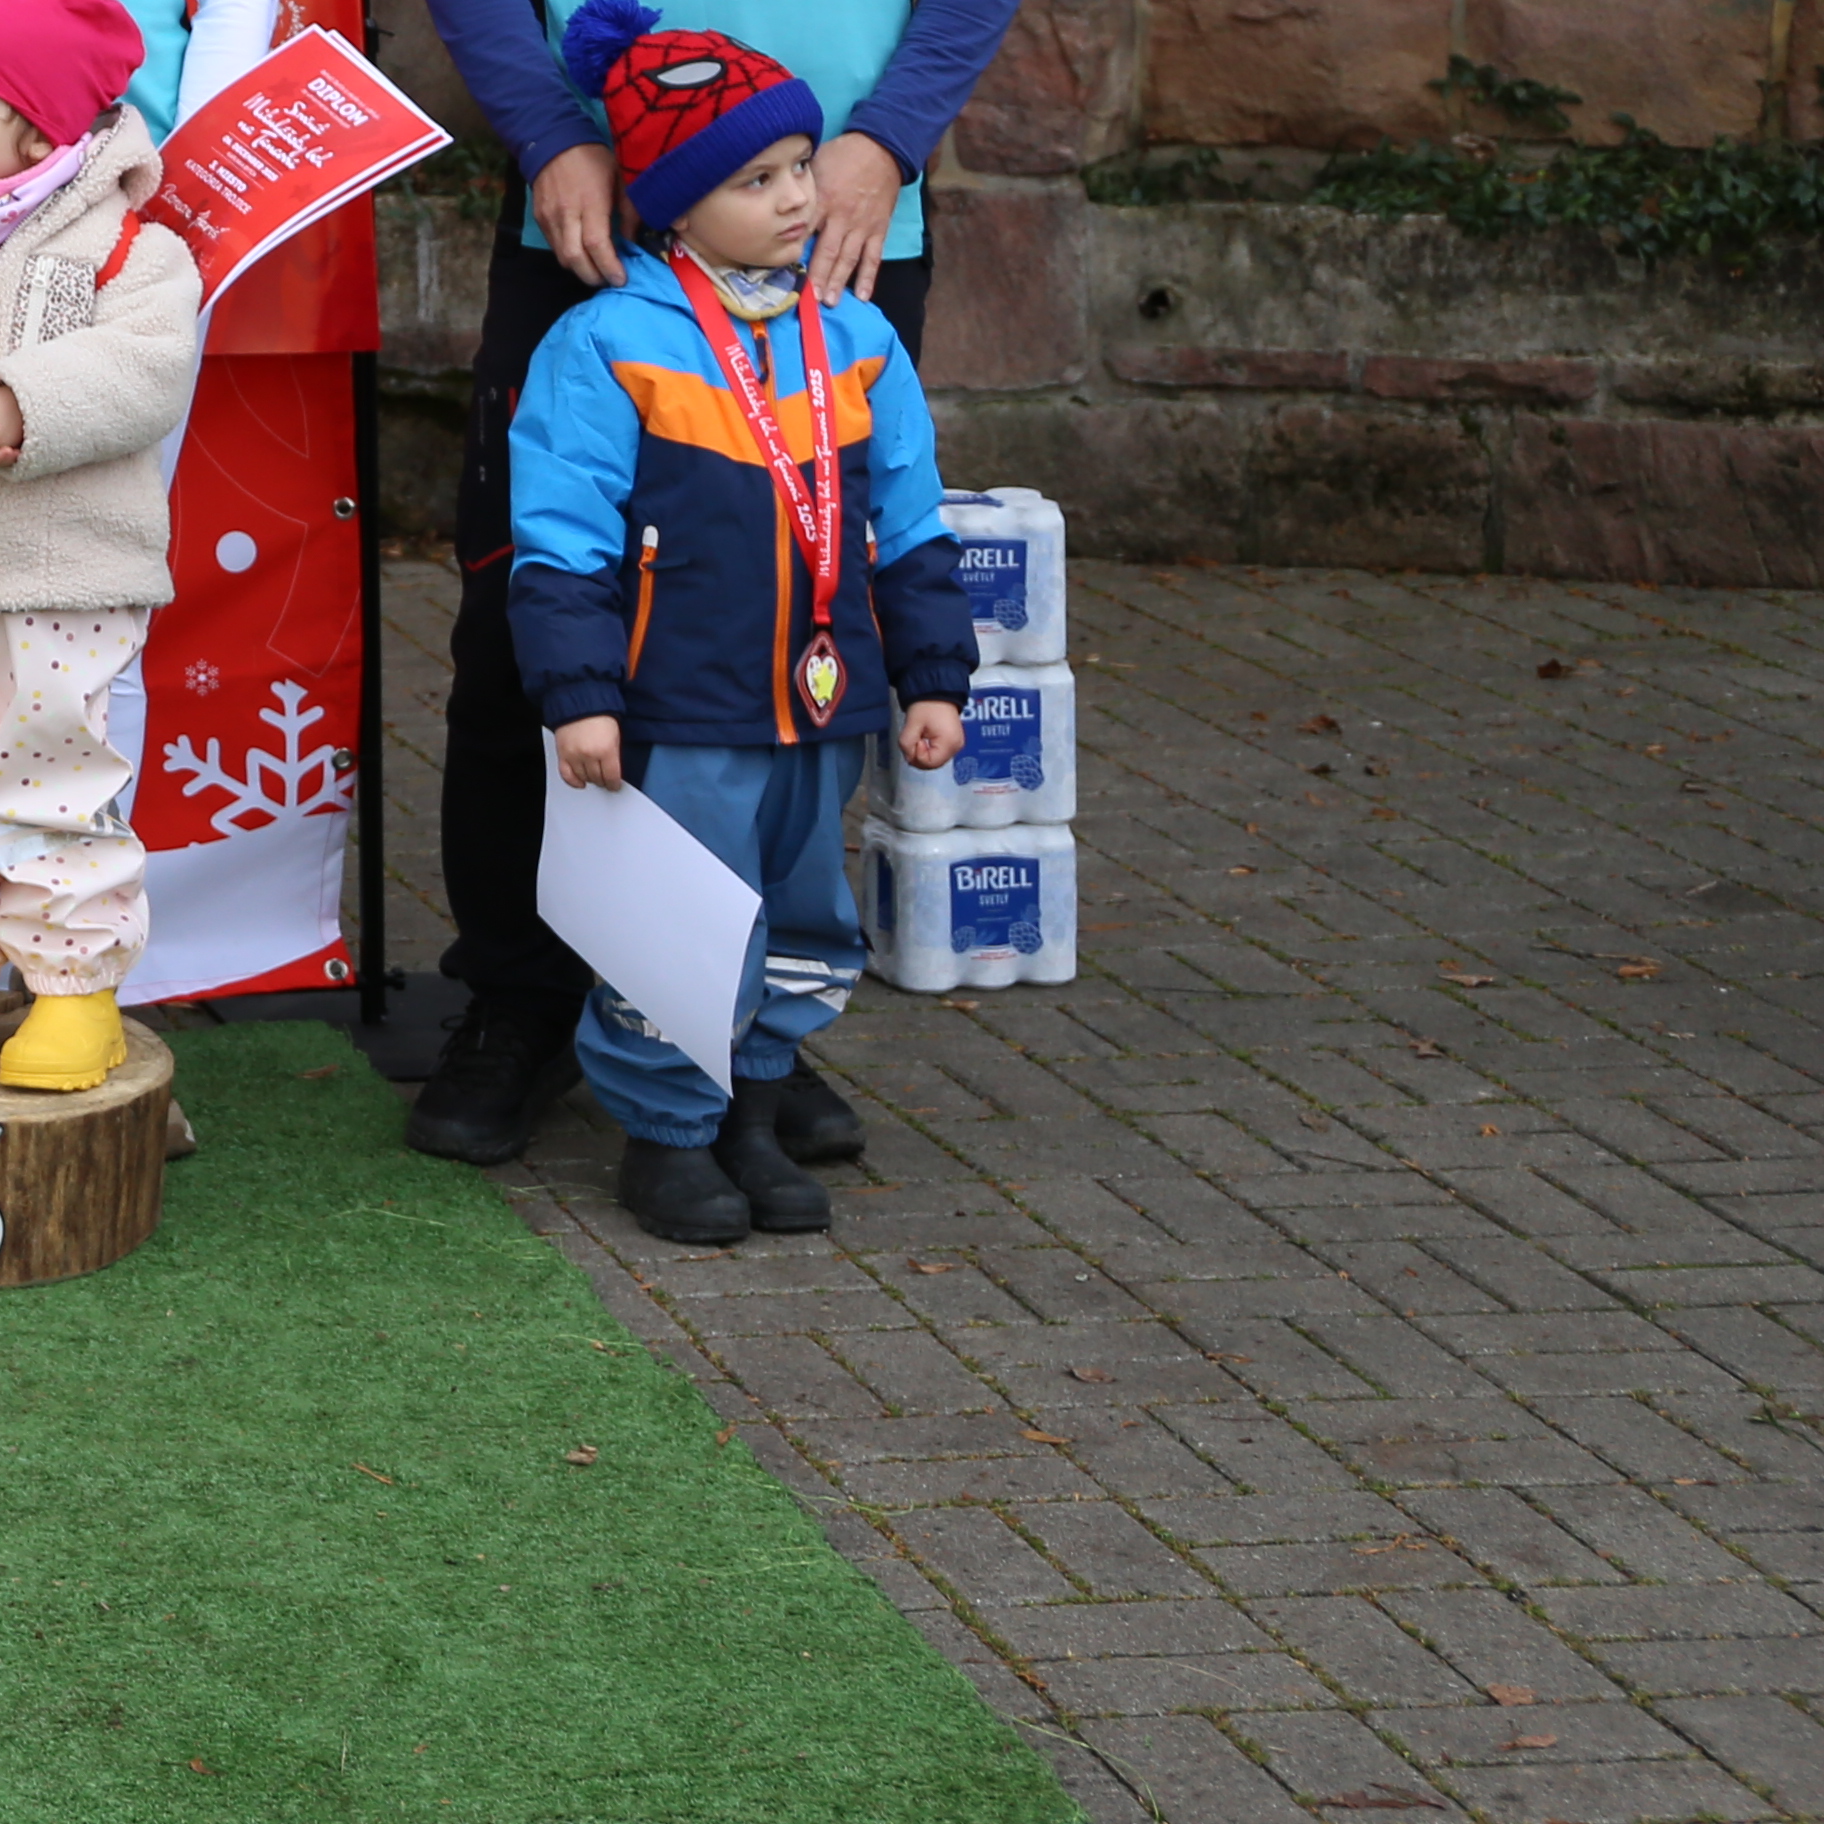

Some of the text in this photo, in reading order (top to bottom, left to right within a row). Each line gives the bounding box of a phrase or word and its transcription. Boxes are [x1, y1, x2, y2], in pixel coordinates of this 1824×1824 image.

[307, 77, 369, 127] DIPLOM
[809, 368, 826, 408] 2025
[796, 502, 819, 543] 2025
[959, 547, 1019, 569] iRELL
[979, 893, 1009, 906] SVETLÝ
